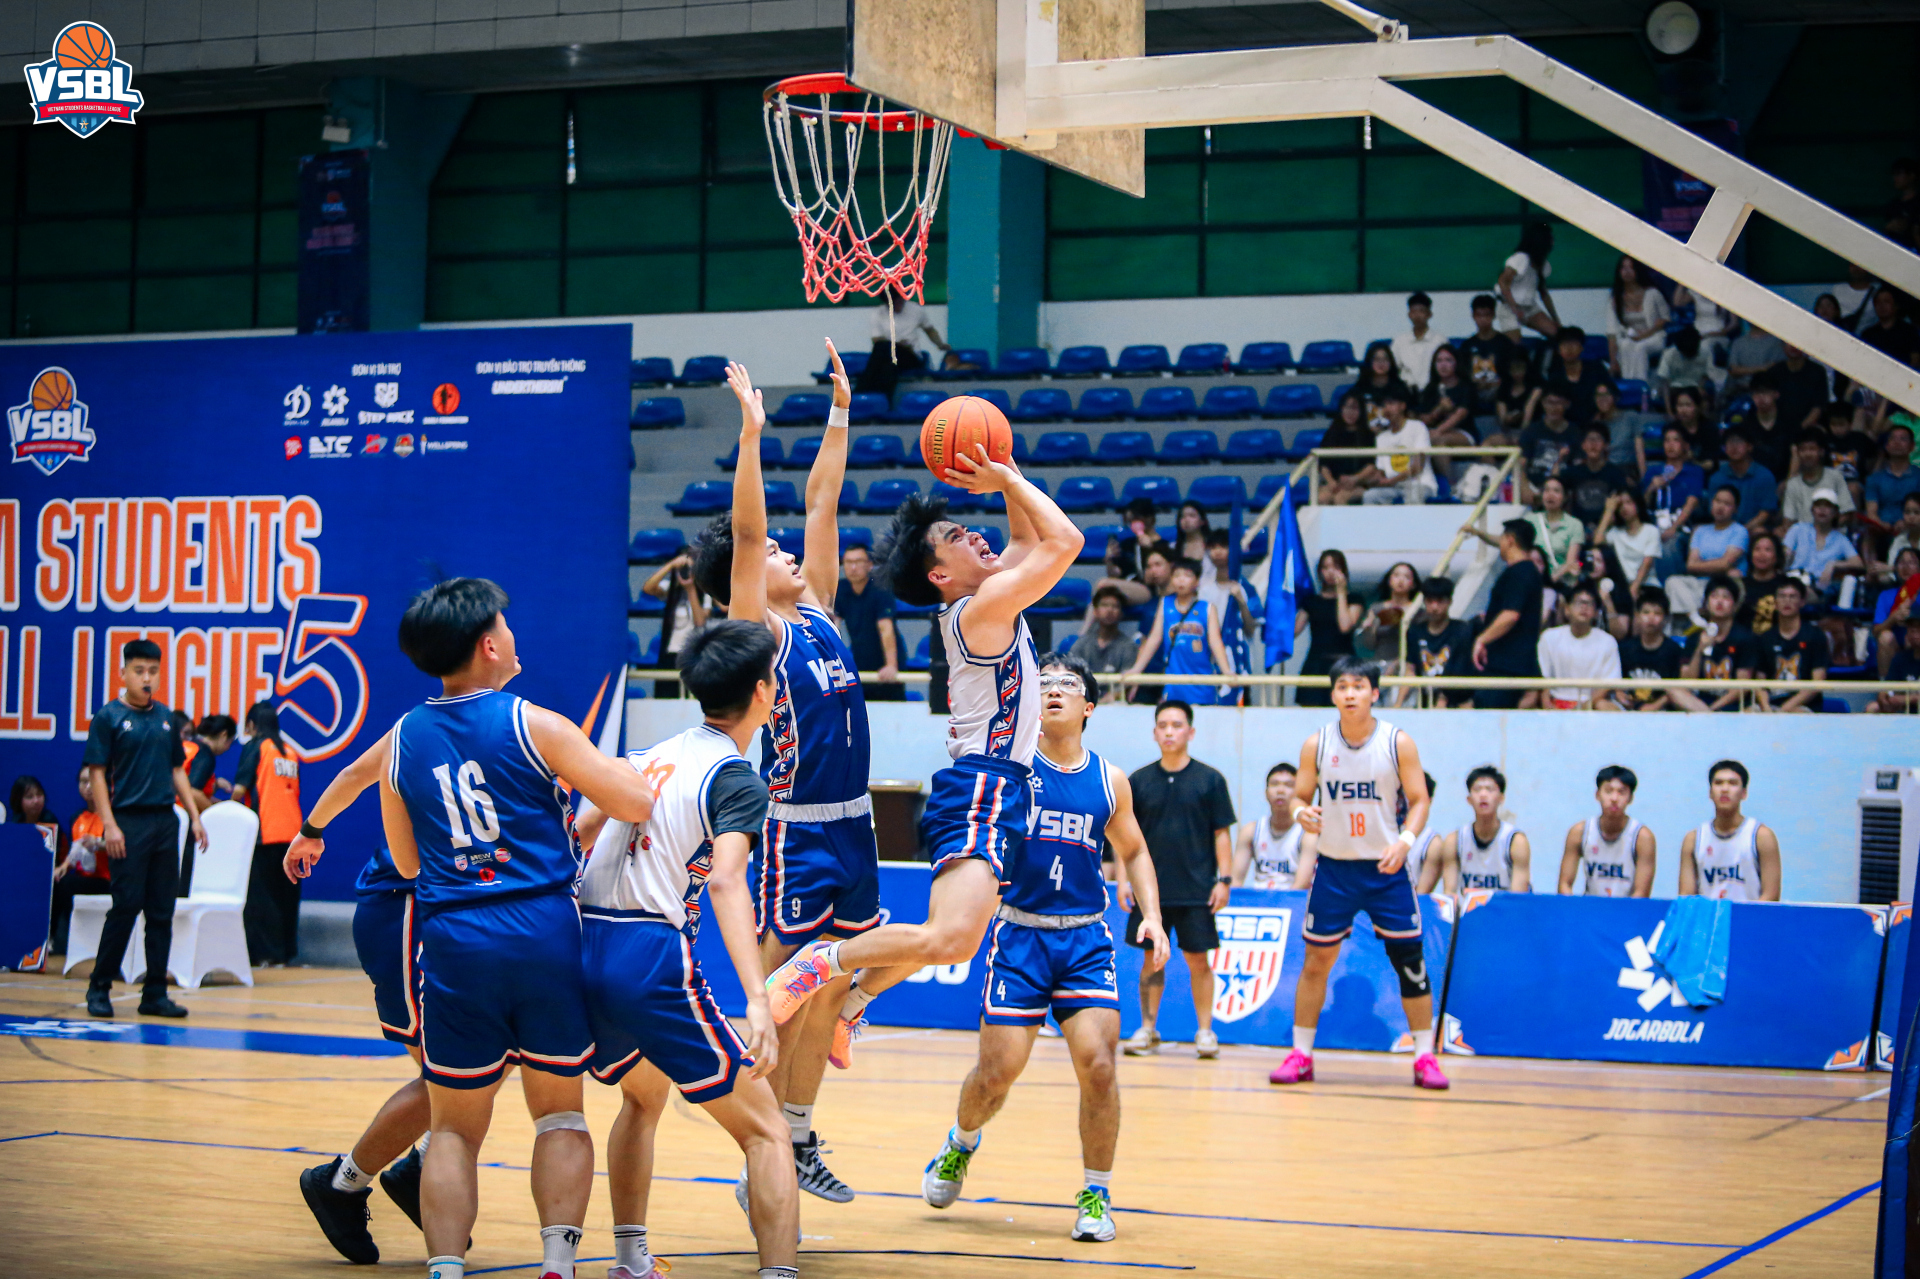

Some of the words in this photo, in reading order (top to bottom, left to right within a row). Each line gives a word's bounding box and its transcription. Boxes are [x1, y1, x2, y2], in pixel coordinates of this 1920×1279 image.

[11, 407, 93, 443] VSBL
[933, 418, 948, 465] SB1000
[36, 495, 322, 612] STUDENTS
[276, 593, 369, 763] 5
[432, 760, 500, 850] 16
[1326, 780, 1383, 801] VSBL
[1349, 812, 1366, 838] 18
[1049, 854, 1064, 891] 4
[1585, 861, 1631, 880] VSBL
[791, 897, 802, 918] 9
[996, 980, 1007, 1001] 4
[1602, 1017, 1705, 1044] JOGARBOLA
